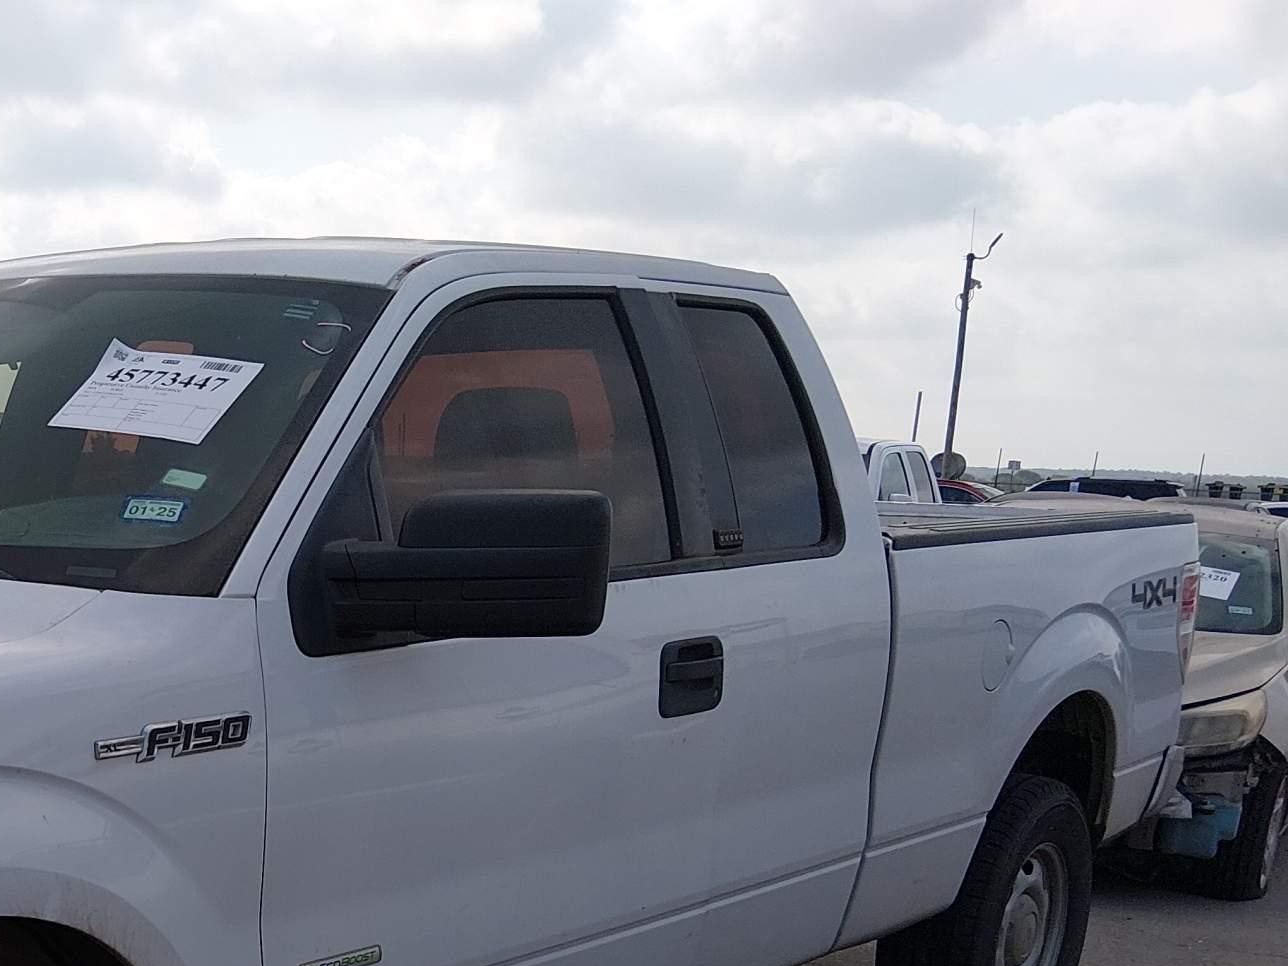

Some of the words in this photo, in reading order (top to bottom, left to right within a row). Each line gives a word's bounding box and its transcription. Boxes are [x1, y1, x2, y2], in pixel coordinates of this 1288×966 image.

[106, 367, 229, 392] 45773447
[129, 505, 147, 516] 01
[156, 506, 177, 517] 25
[136, 711, 252, 763] F-150
